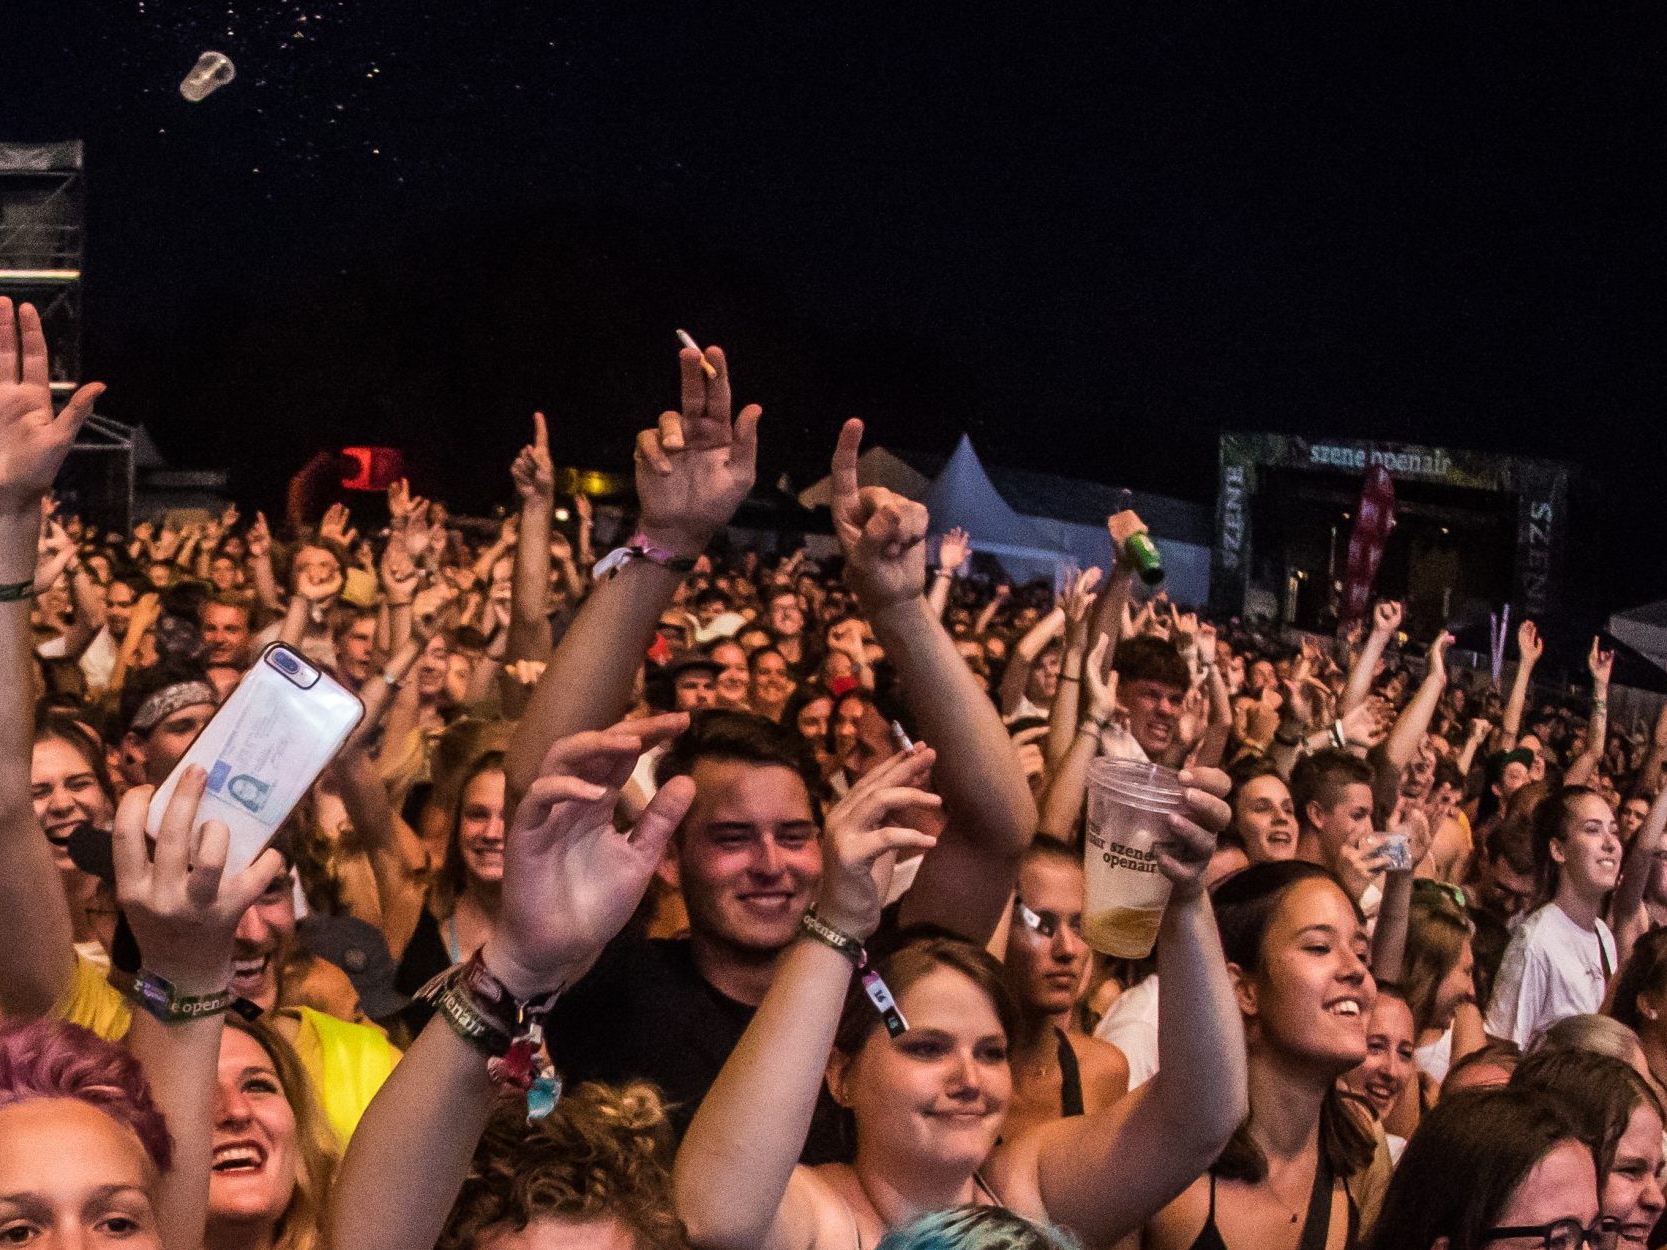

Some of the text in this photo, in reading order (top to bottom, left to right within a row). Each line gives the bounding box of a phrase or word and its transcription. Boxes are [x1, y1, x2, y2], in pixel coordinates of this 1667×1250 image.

[1310, 444, 1366, 466] szene
[1110, 842, 1159, 862] szene
[1102, 853, 1158, 874] openair
[803, 915, 847, 947] openair
[182, 999, 224, 1016] open
